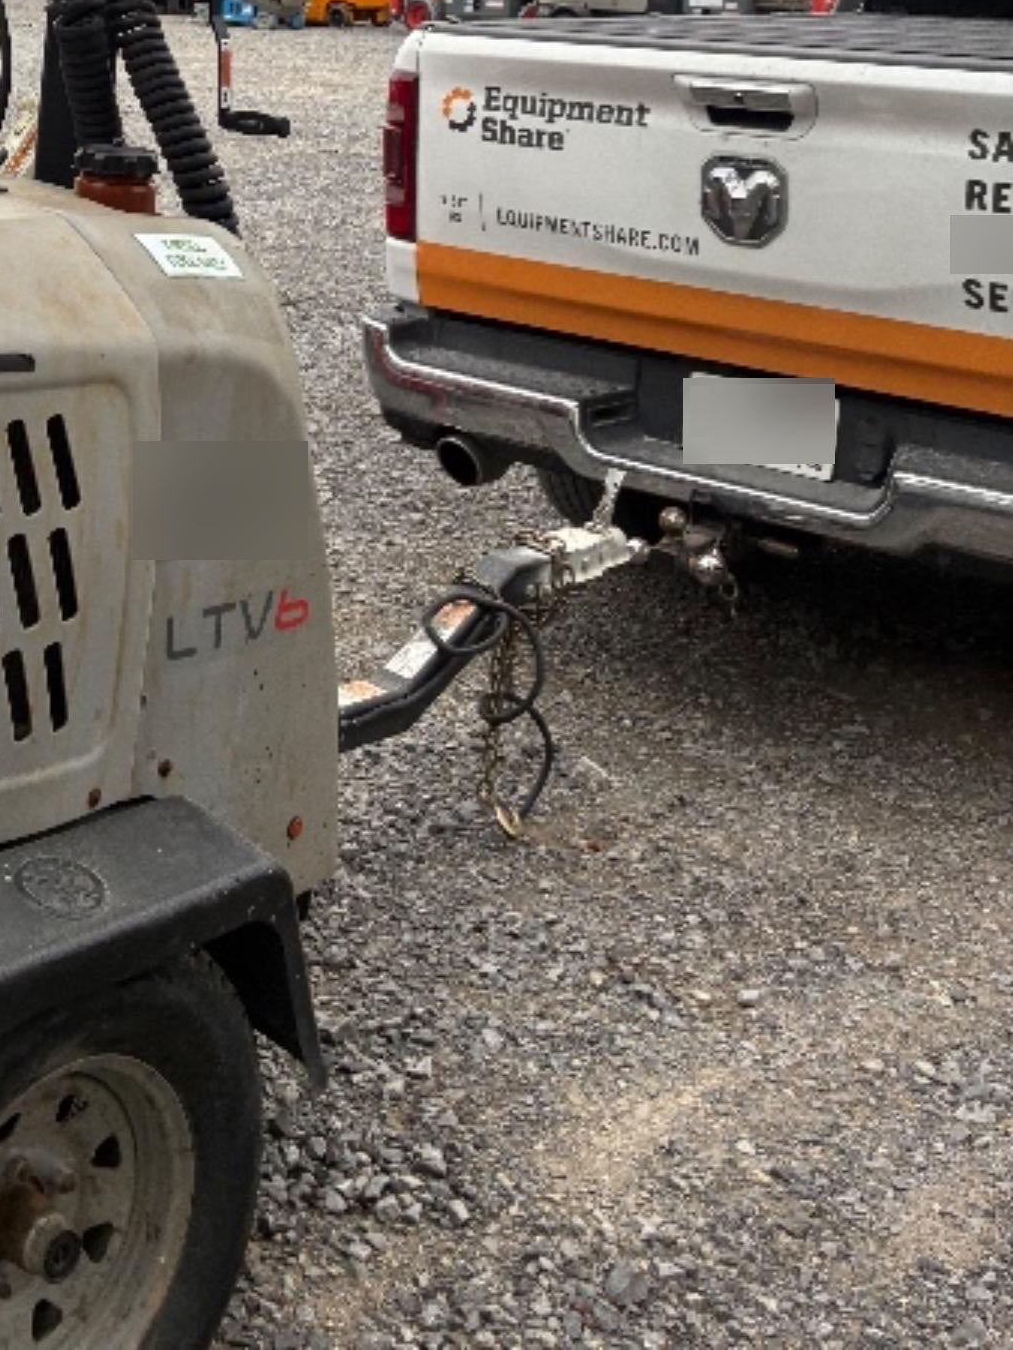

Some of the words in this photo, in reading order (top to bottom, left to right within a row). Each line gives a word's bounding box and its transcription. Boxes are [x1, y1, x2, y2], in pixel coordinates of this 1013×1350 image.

[482, 86, 651, 128] Equipment
[481, 116, 565, 151] Share
[967, 127, 1013, 164] SA
[963, 178, 1013, 214] RE
[495, 205, 701, 256] EQUIPMENTSHARE.COM
[961, 277, 1009, 314] SE
[166, 588, 309, 660] LTV6
